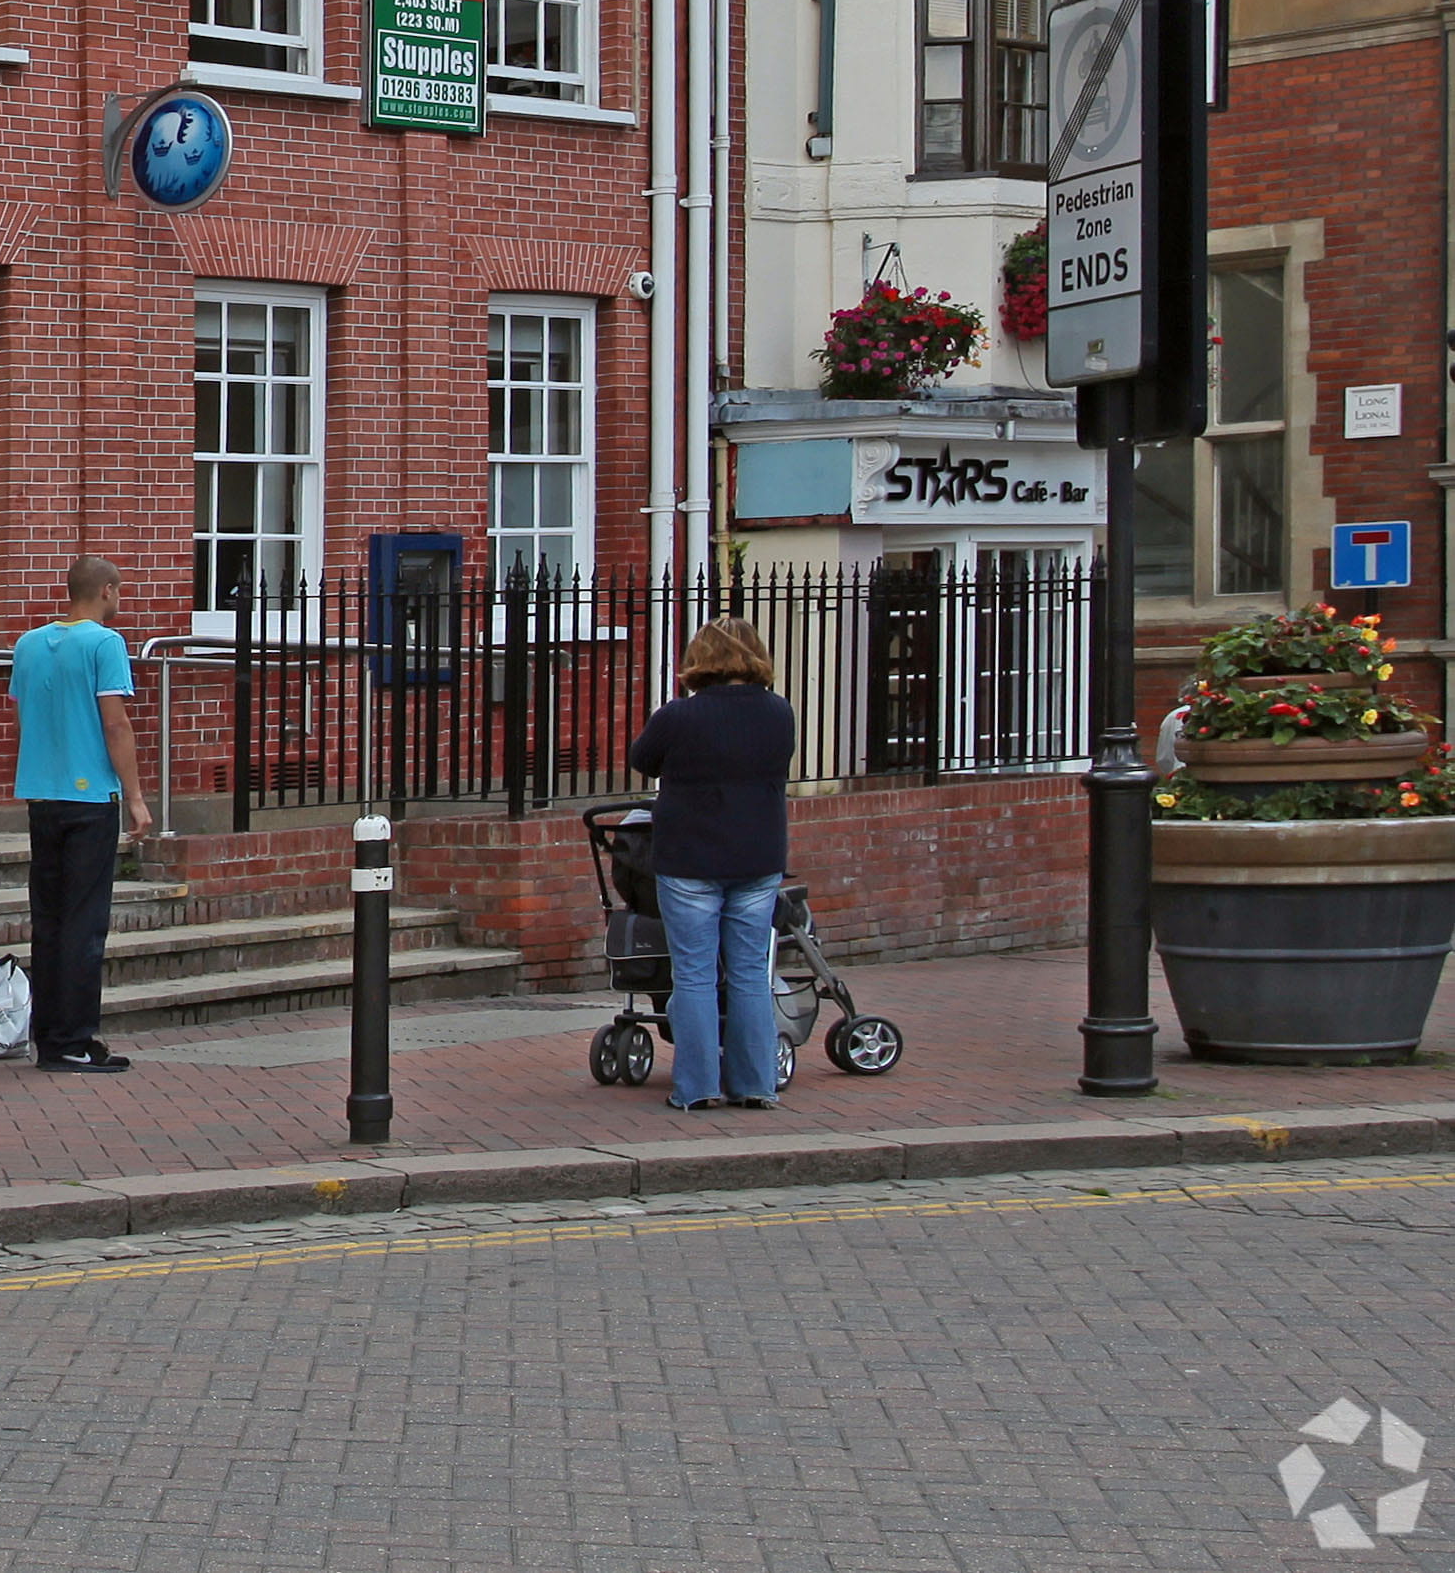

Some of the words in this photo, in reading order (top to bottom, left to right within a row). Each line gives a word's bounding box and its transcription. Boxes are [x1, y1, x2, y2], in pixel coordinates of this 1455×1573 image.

[396, 11, 422, 29] (223
[425, 15, 460, 34] SQ.M)
[383, 37, 474, 77] Stupples
[382, 78, 420, 98] 01296
[426, 83, 472, 104] 398383
[382, 101, 473, 119] www.stupples.com
[1055, 180, 1134, 216] Pedestrian
[1076, 216, 1112, 241] Zone
[1061, 247, 1129, 292] ENDS
[1011, 480, 1048, 503] Café
[1060, 481, 1090, 503] Bar
